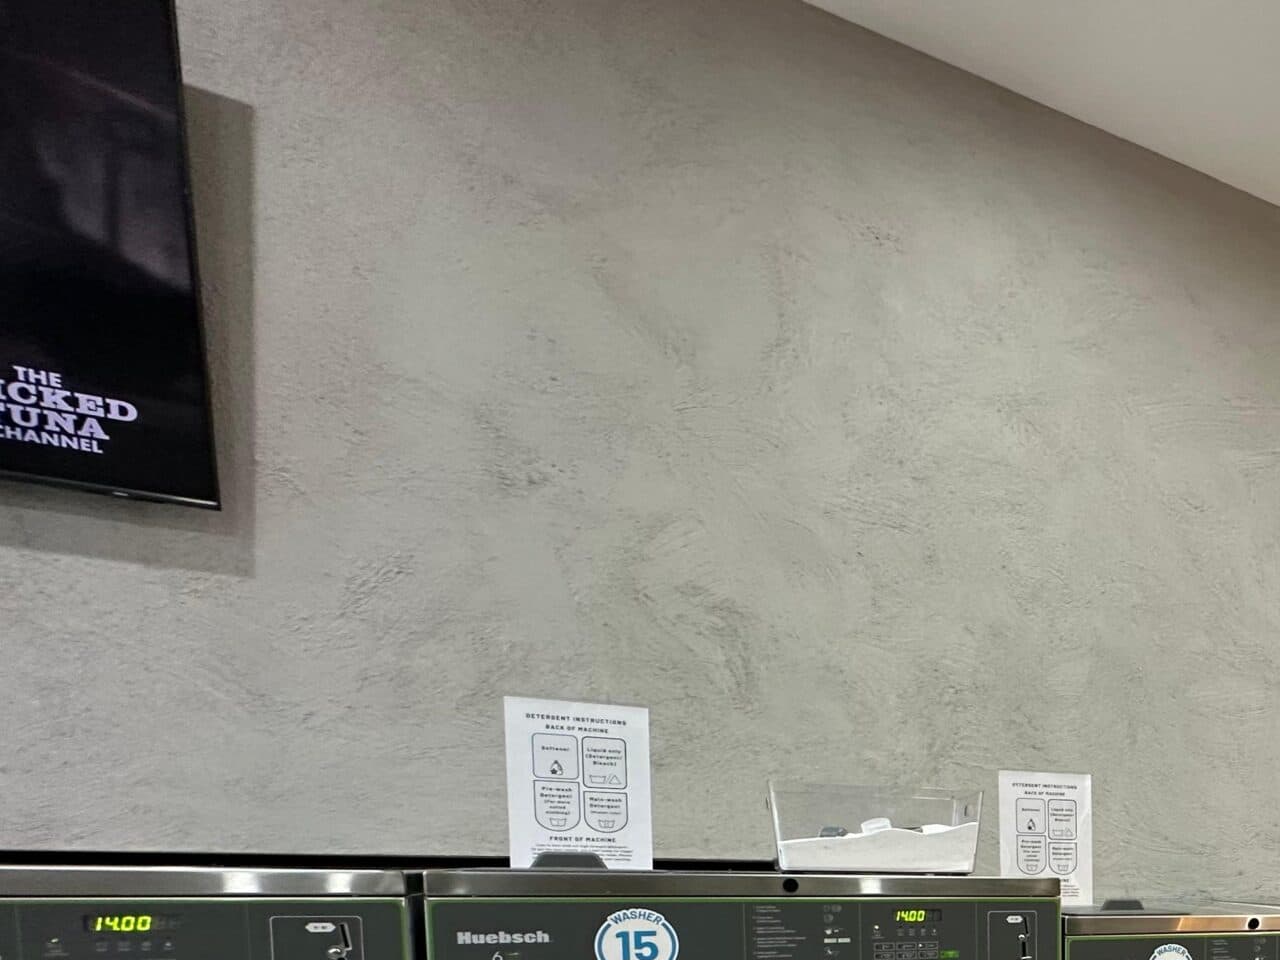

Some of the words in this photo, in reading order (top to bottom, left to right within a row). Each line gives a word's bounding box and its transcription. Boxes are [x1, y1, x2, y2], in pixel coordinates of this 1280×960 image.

[12, 365, 62, 388] THE
[0, 402, 110, 441] UNA
[525, 713, 570, 721] DETERGENT
[572, 716, 627, 726] INSTRUCTIONS
[577, 726, 609, 734] MACHINE
[95, 915, 152, 932] 14.00
[609, 909, 663, 926] WASHER
[896, 910, 926, 922] 14.00
[456, 930, 550, 945] Huebsch
[1156, 945, 1187, 956] WASHER
